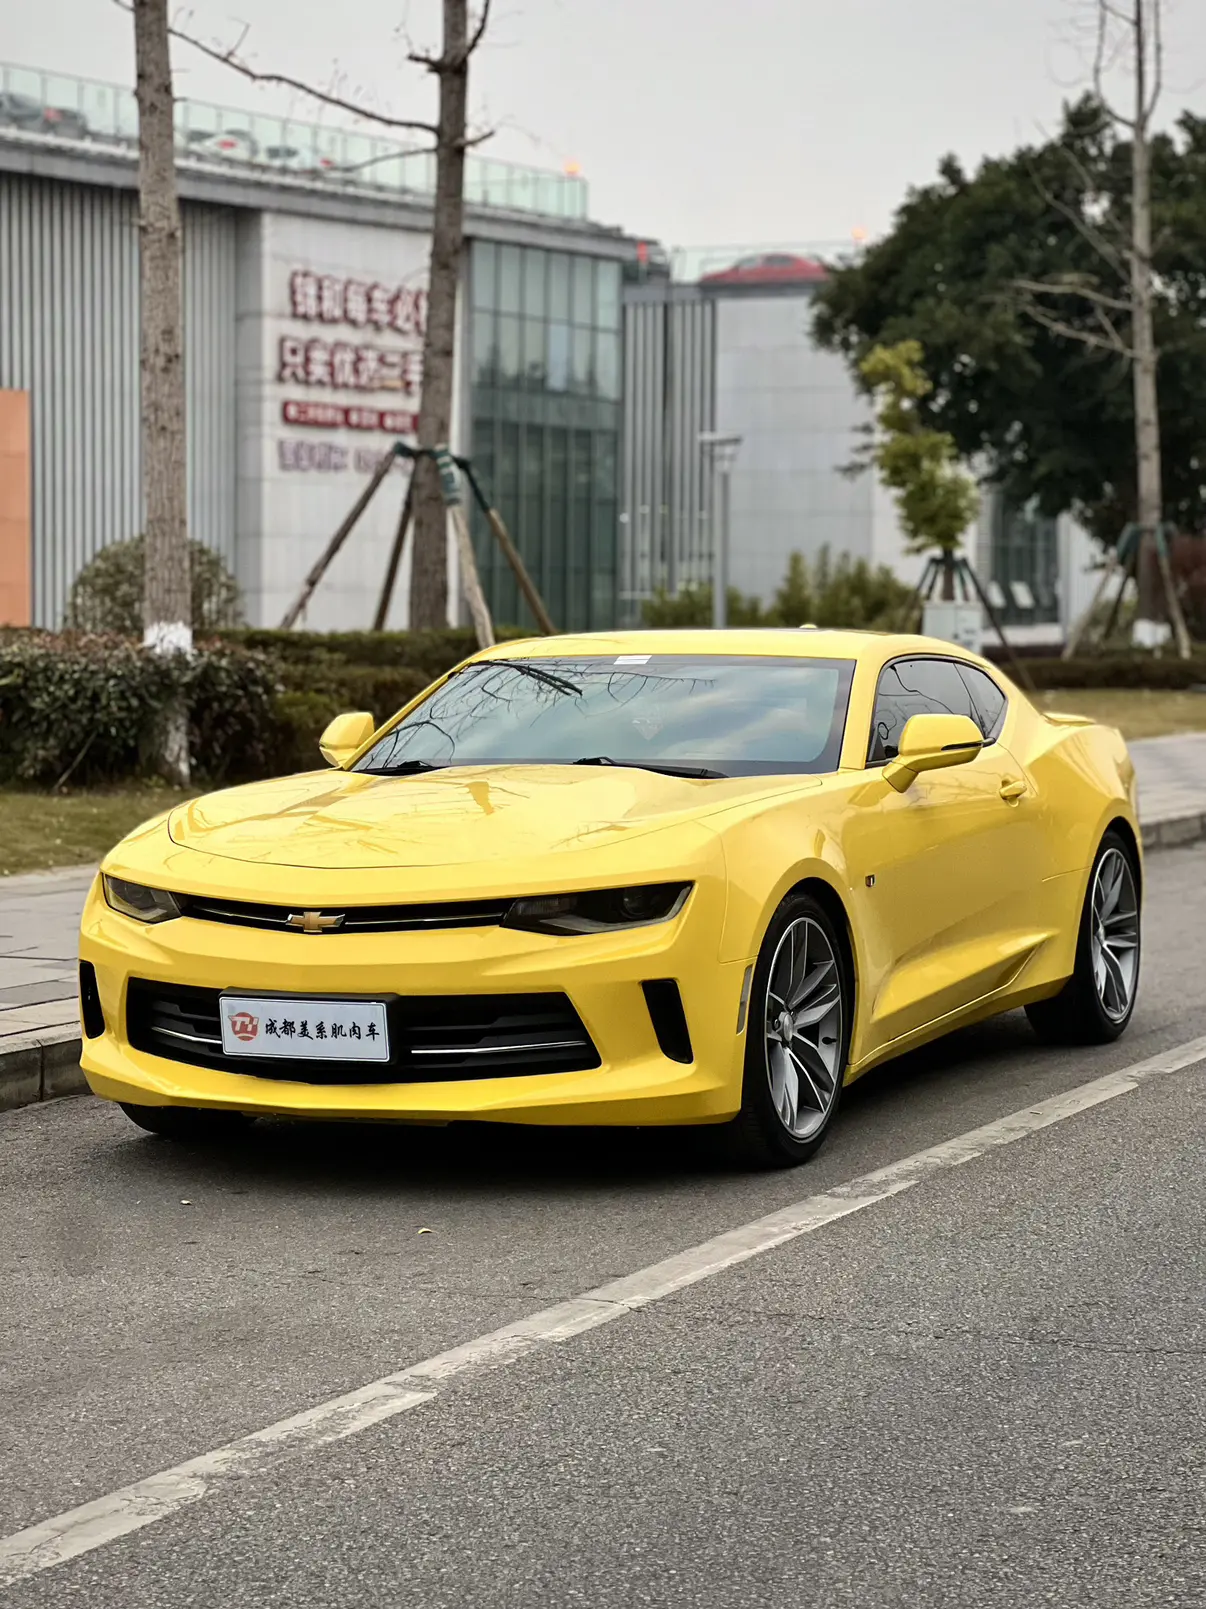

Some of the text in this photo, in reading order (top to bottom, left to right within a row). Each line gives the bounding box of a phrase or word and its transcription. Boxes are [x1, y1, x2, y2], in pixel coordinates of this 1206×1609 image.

[265, 1018, 380, 1041] 成都美系肌肉车
